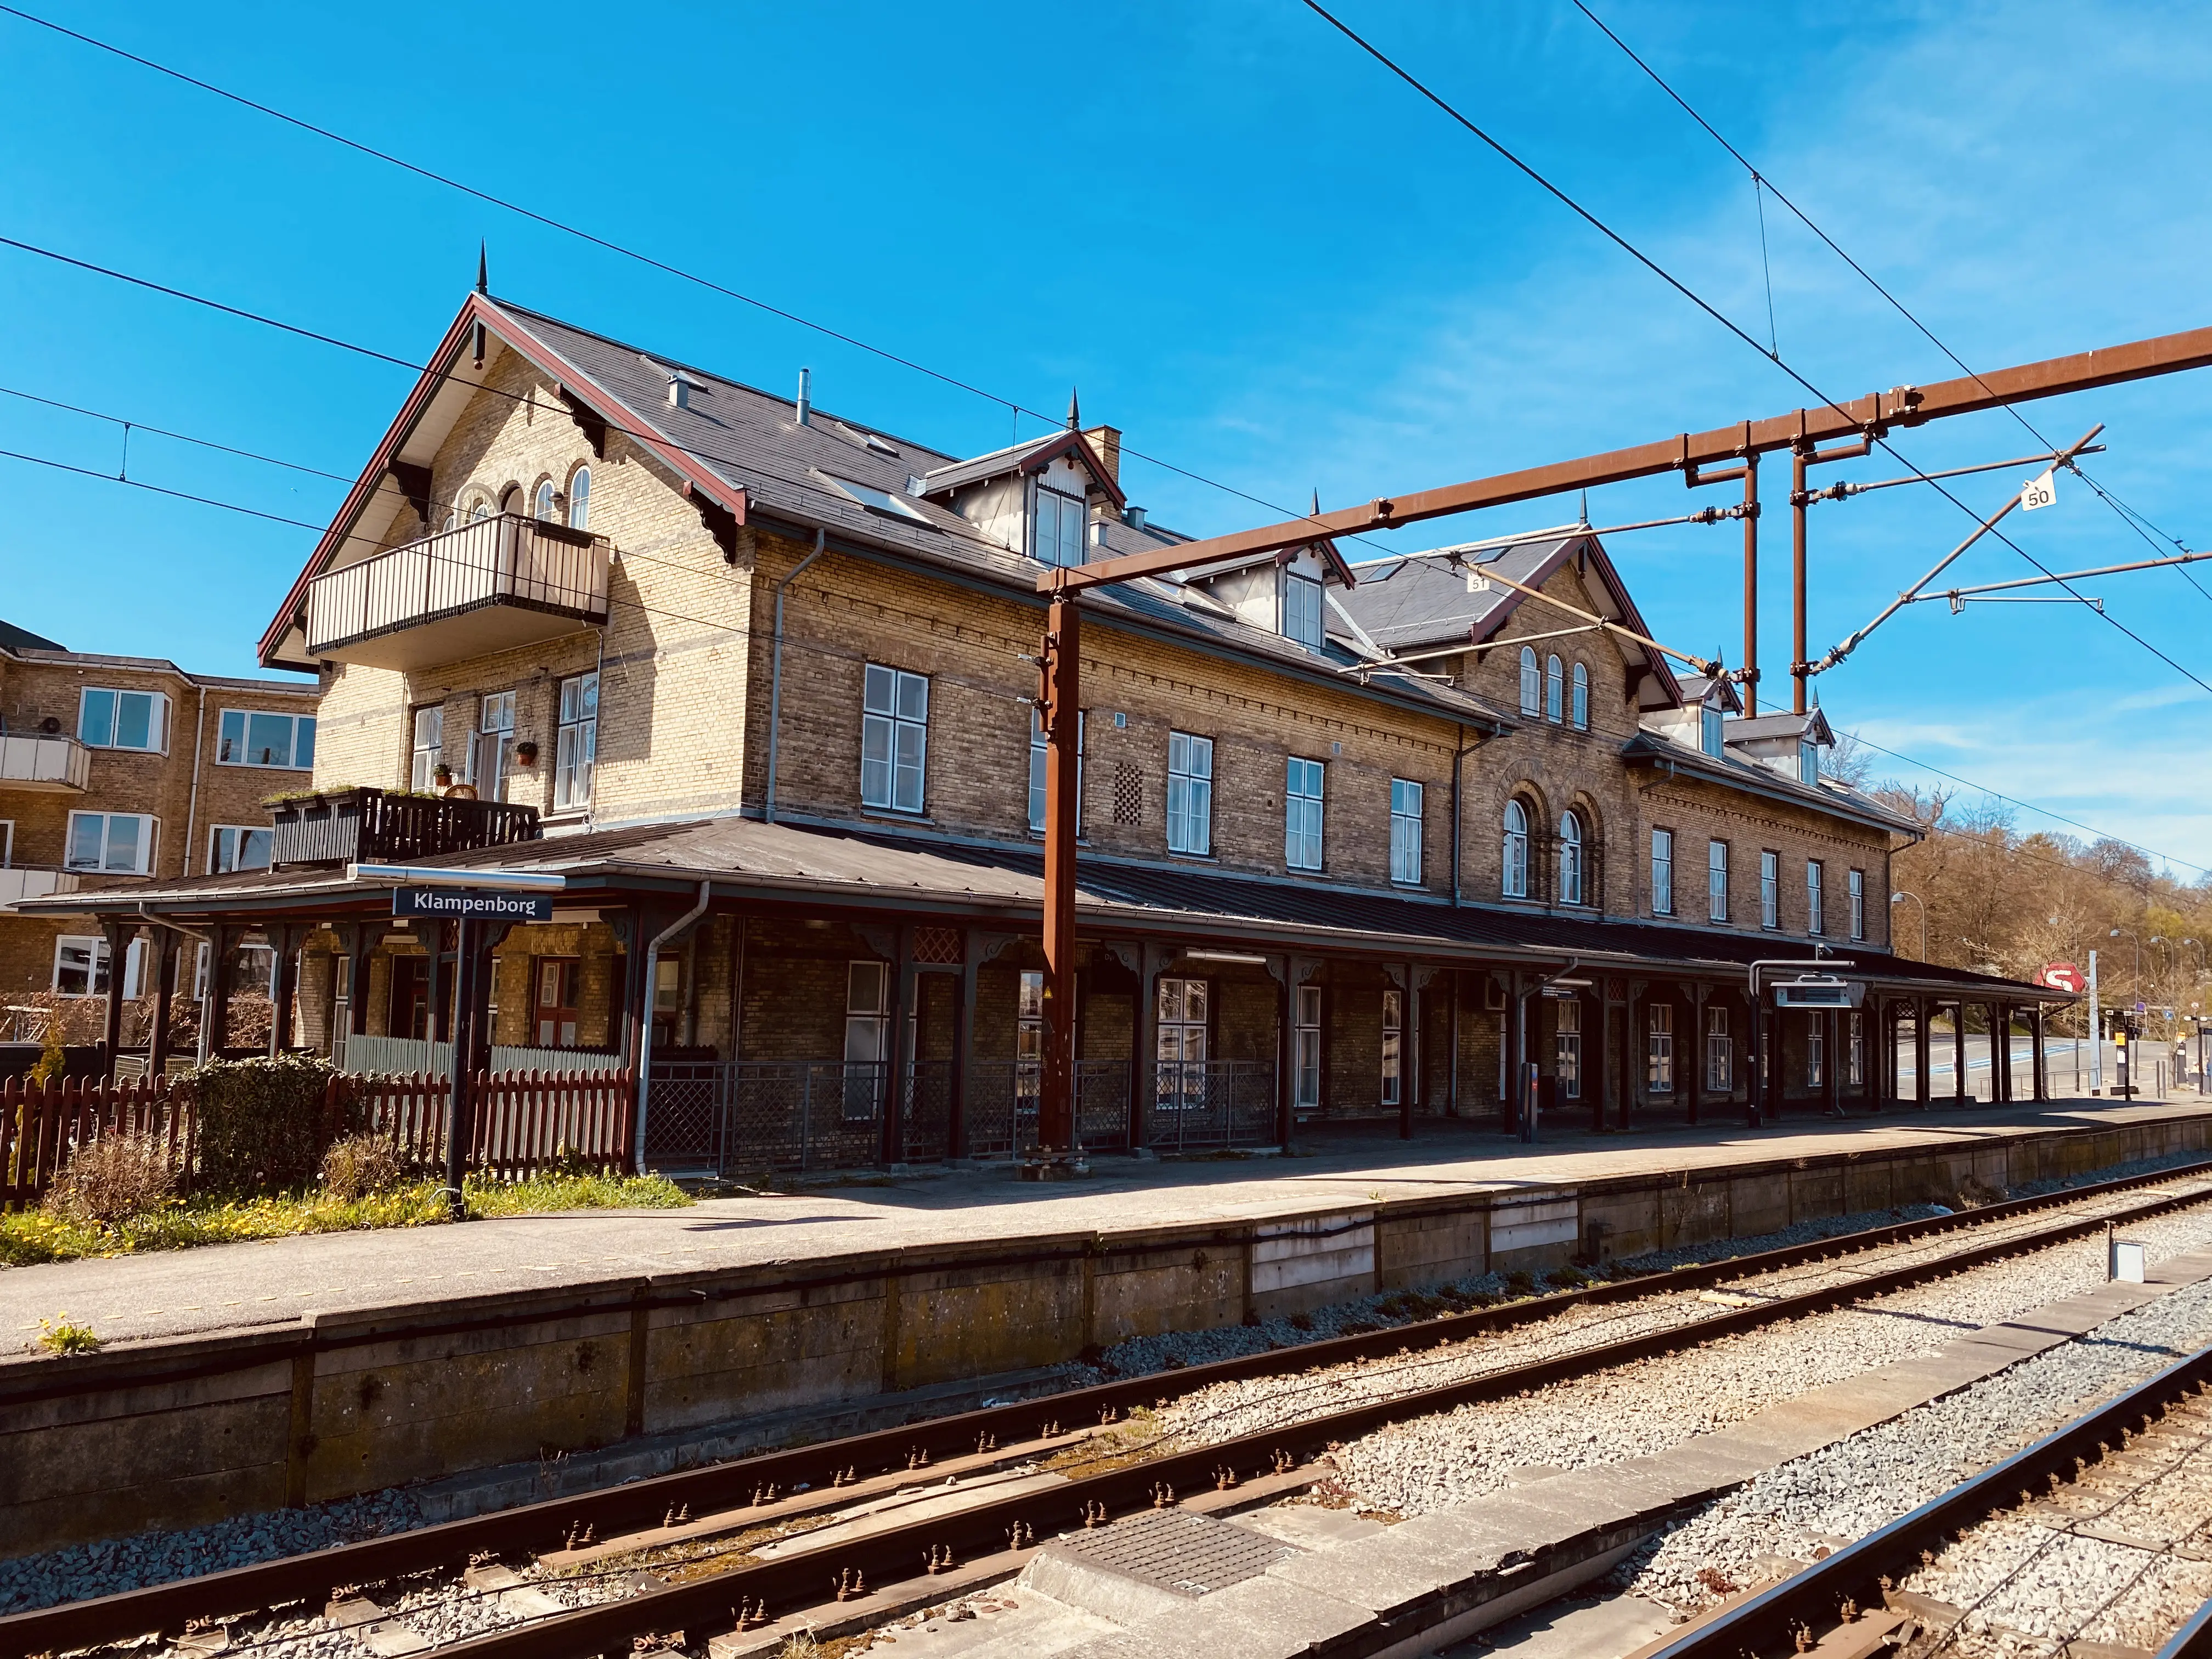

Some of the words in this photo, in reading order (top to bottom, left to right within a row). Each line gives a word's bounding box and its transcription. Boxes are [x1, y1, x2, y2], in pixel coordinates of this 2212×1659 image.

[2029, 491, 2049, 506] 50
[1473, 578, 1484, 589] 51
[414, 893, 535, 916] Klampenborg
